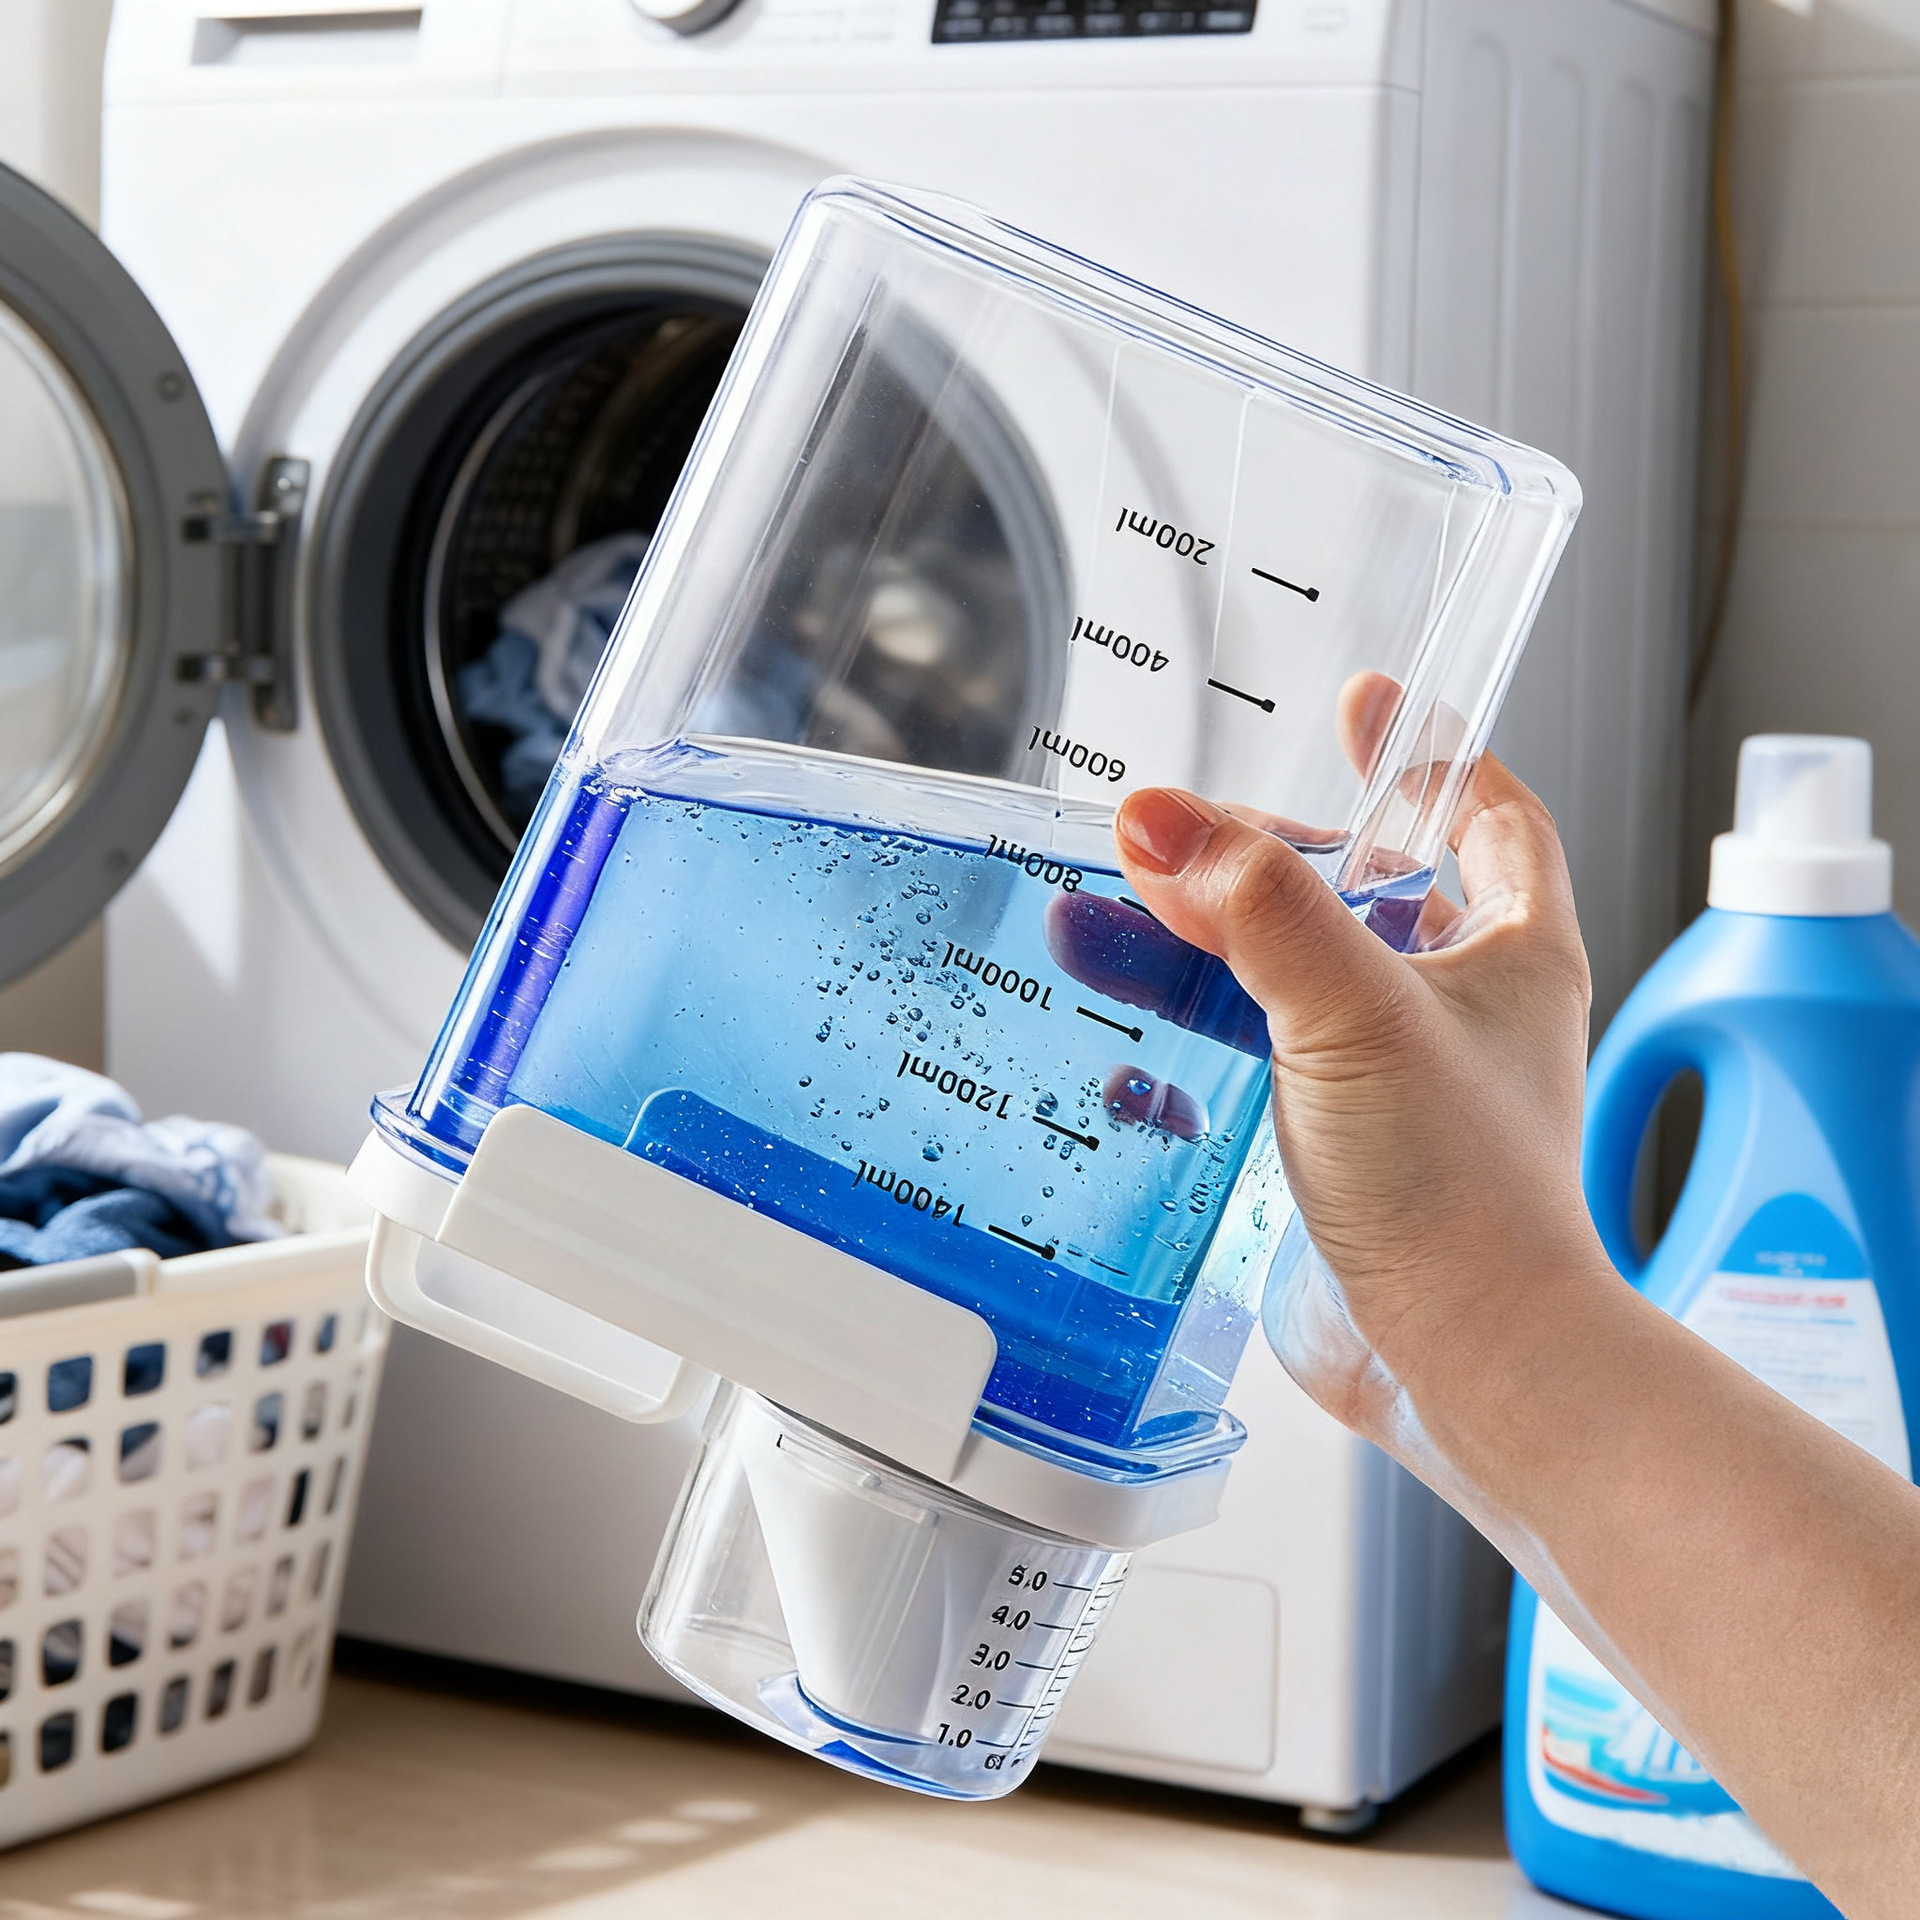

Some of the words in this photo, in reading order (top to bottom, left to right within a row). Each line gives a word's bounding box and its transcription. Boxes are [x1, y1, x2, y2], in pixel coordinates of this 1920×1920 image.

[1115, 507, 1215, 565] 200ml
[1070, 616, 1169, 672] 400ml
[1028, 726, 1126, 782] 600ml
[984, 834, 1083, 893] 800ml
[940, 941, 1053, 1011] 1000ml
[897, 1050, 1013, 1120] 1200ml
[852, 1159, 965, 1227] 1400ml
[951, 1684, 991, 1710] 2.0
[938, 1723, 972, 1748] 1.0
